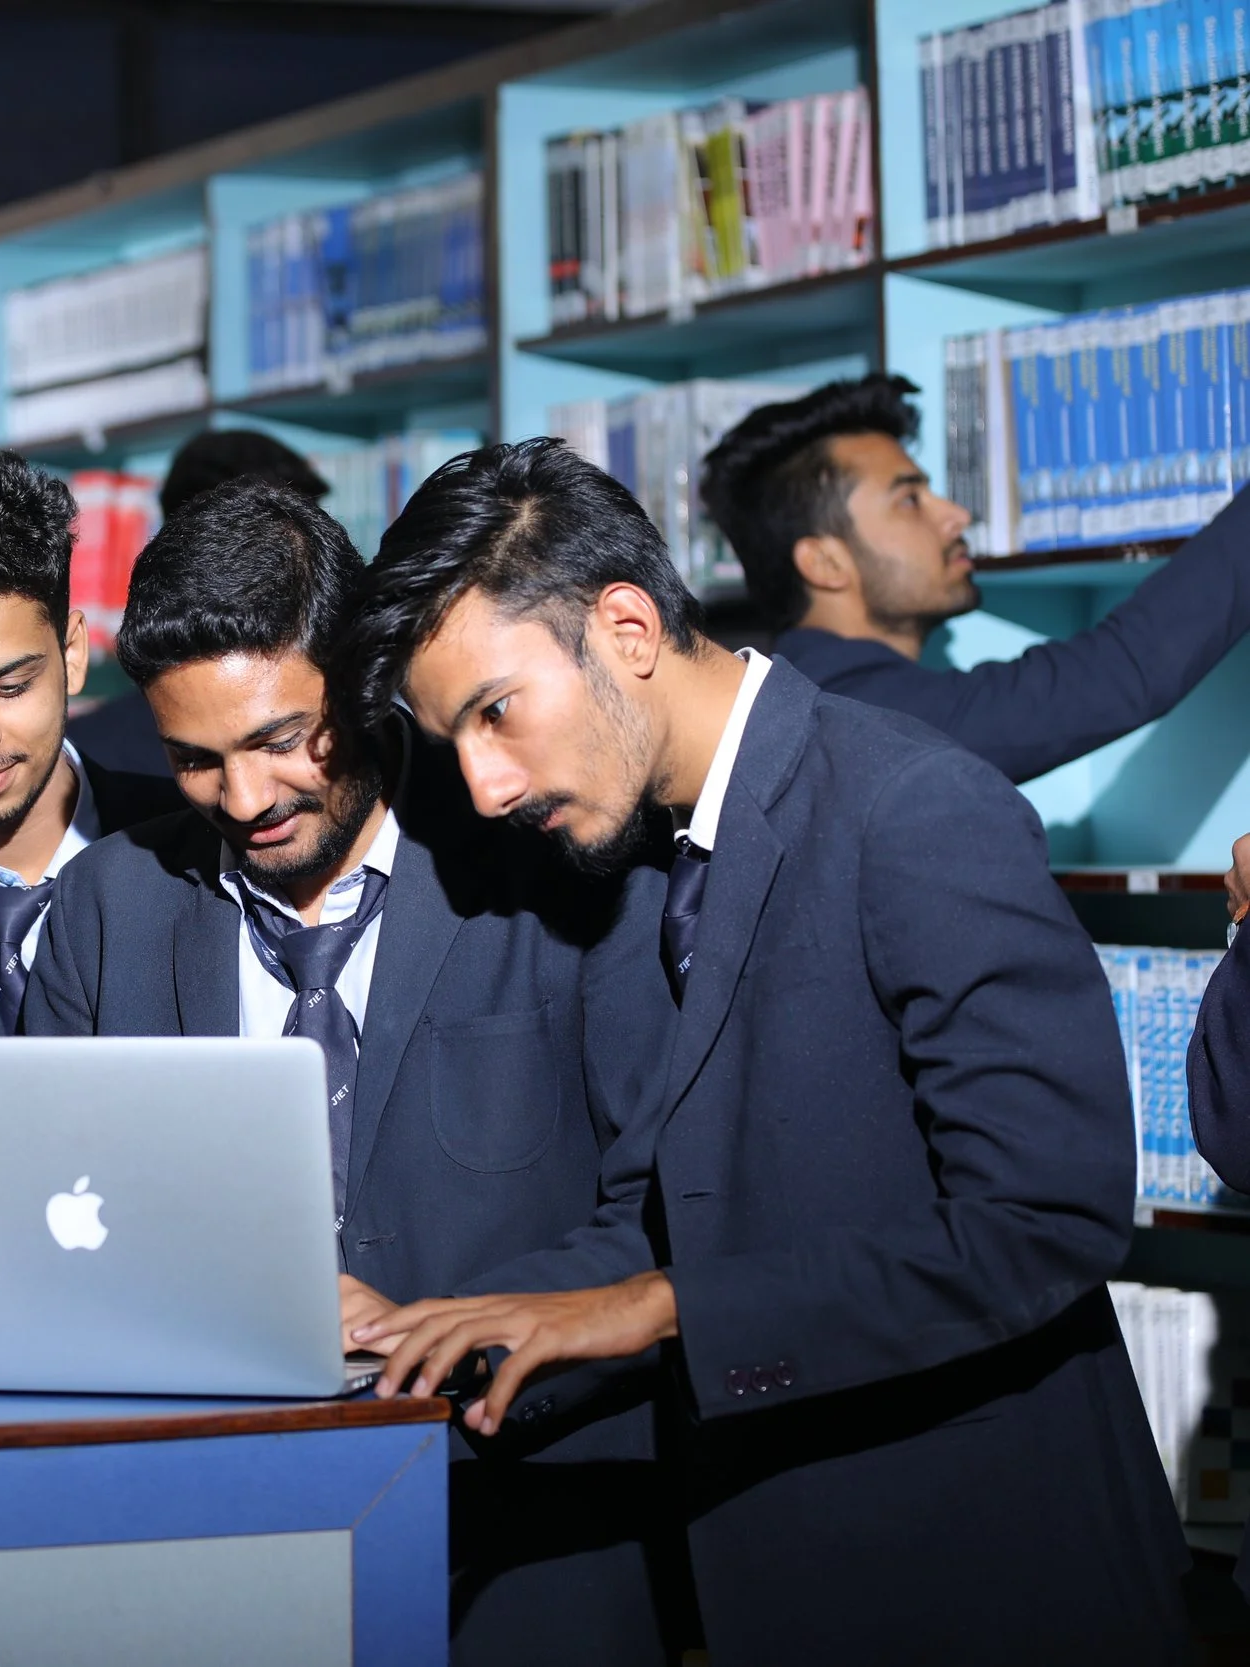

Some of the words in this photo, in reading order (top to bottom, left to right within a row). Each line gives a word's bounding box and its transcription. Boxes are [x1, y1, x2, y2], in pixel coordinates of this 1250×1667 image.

[5, 952, 19, 975] JIET
[307, 988, 326, 1008] JIET
[1154, 988, 1167, 1137] URVEYING
[1170, 988, 1185, 1137] URVEYING
[331, 1084, 349, 1106] JIET
[333, 1215, 345, 1233] IET
